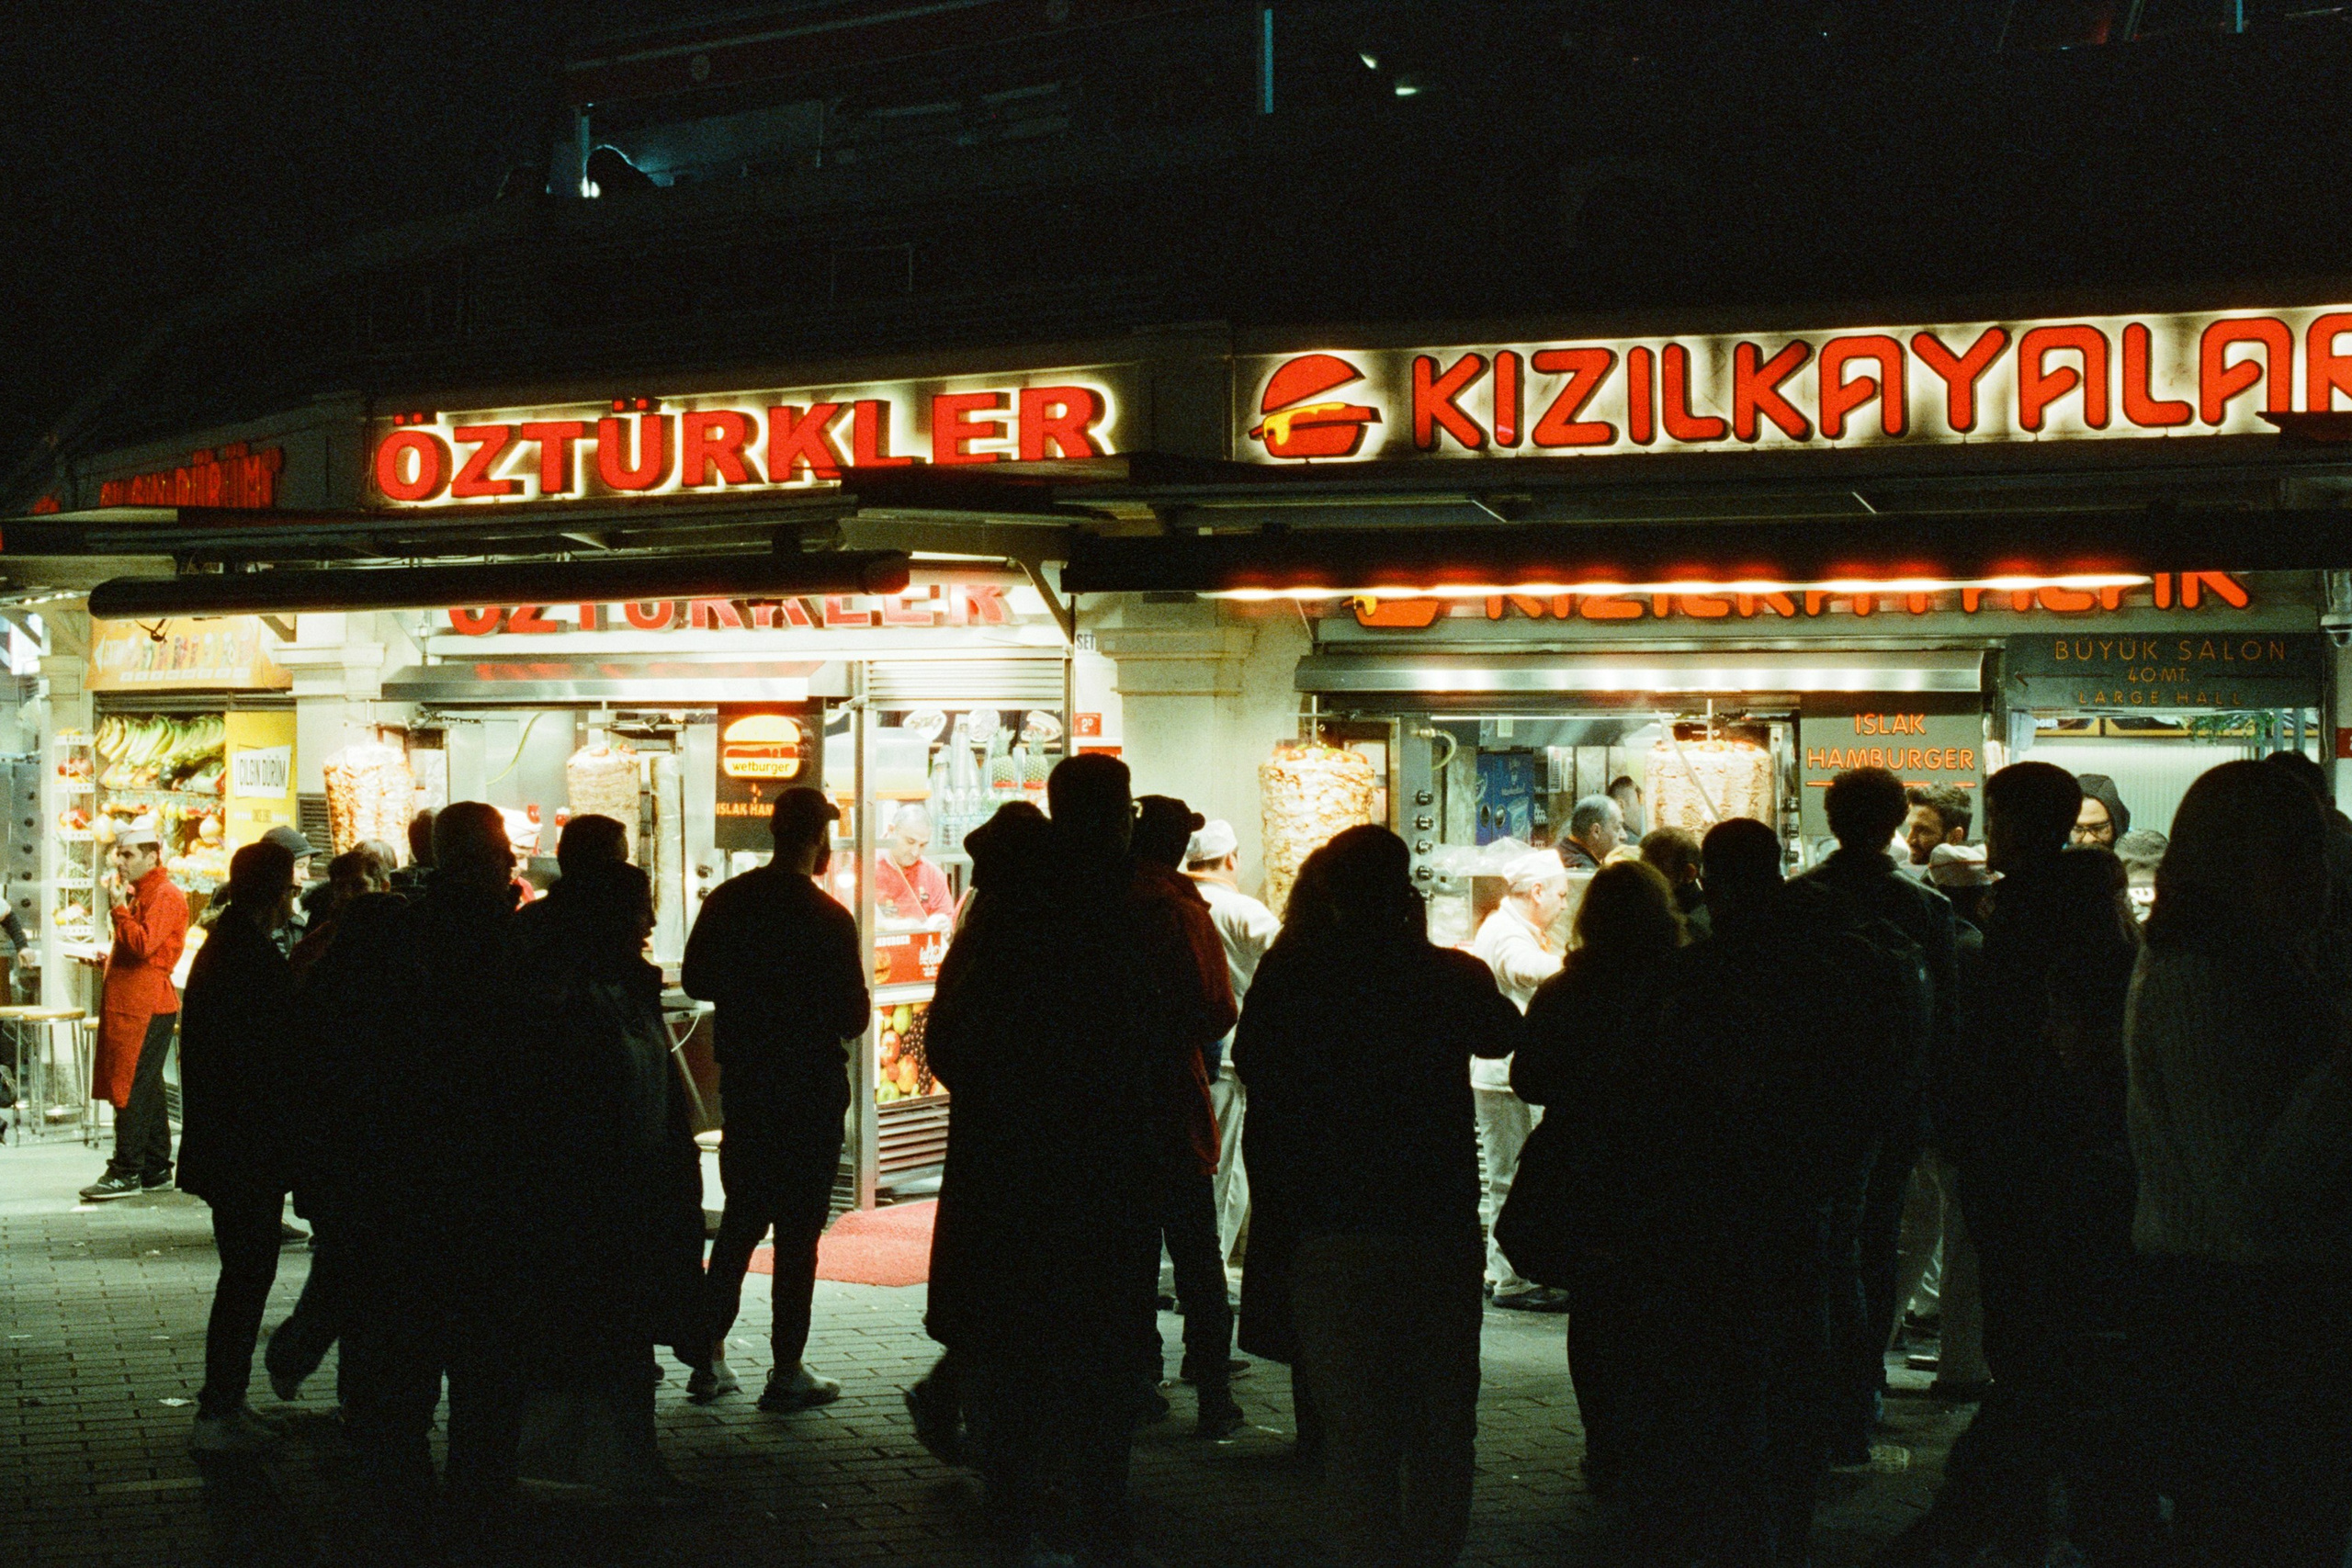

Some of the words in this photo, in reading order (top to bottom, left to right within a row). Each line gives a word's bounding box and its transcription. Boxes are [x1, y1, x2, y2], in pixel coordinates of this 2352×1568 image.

[375, 386, 1115, 502] ÖZTÜRKLER
[2054, 637, 2159, 660] BÜYÜK
[2178, 641, 2286, 660] SALON
[2078, 691, 2159, 705] LARGE
[2176, 691, 2242, 705] HALL
[1854, 714, 1927, 735] ISLAK
[733, 761, 790, 774] wetburger
[1806, 748, 1974, 770] HAMBURGER
[717, 803, 748, 816] ISLAK
